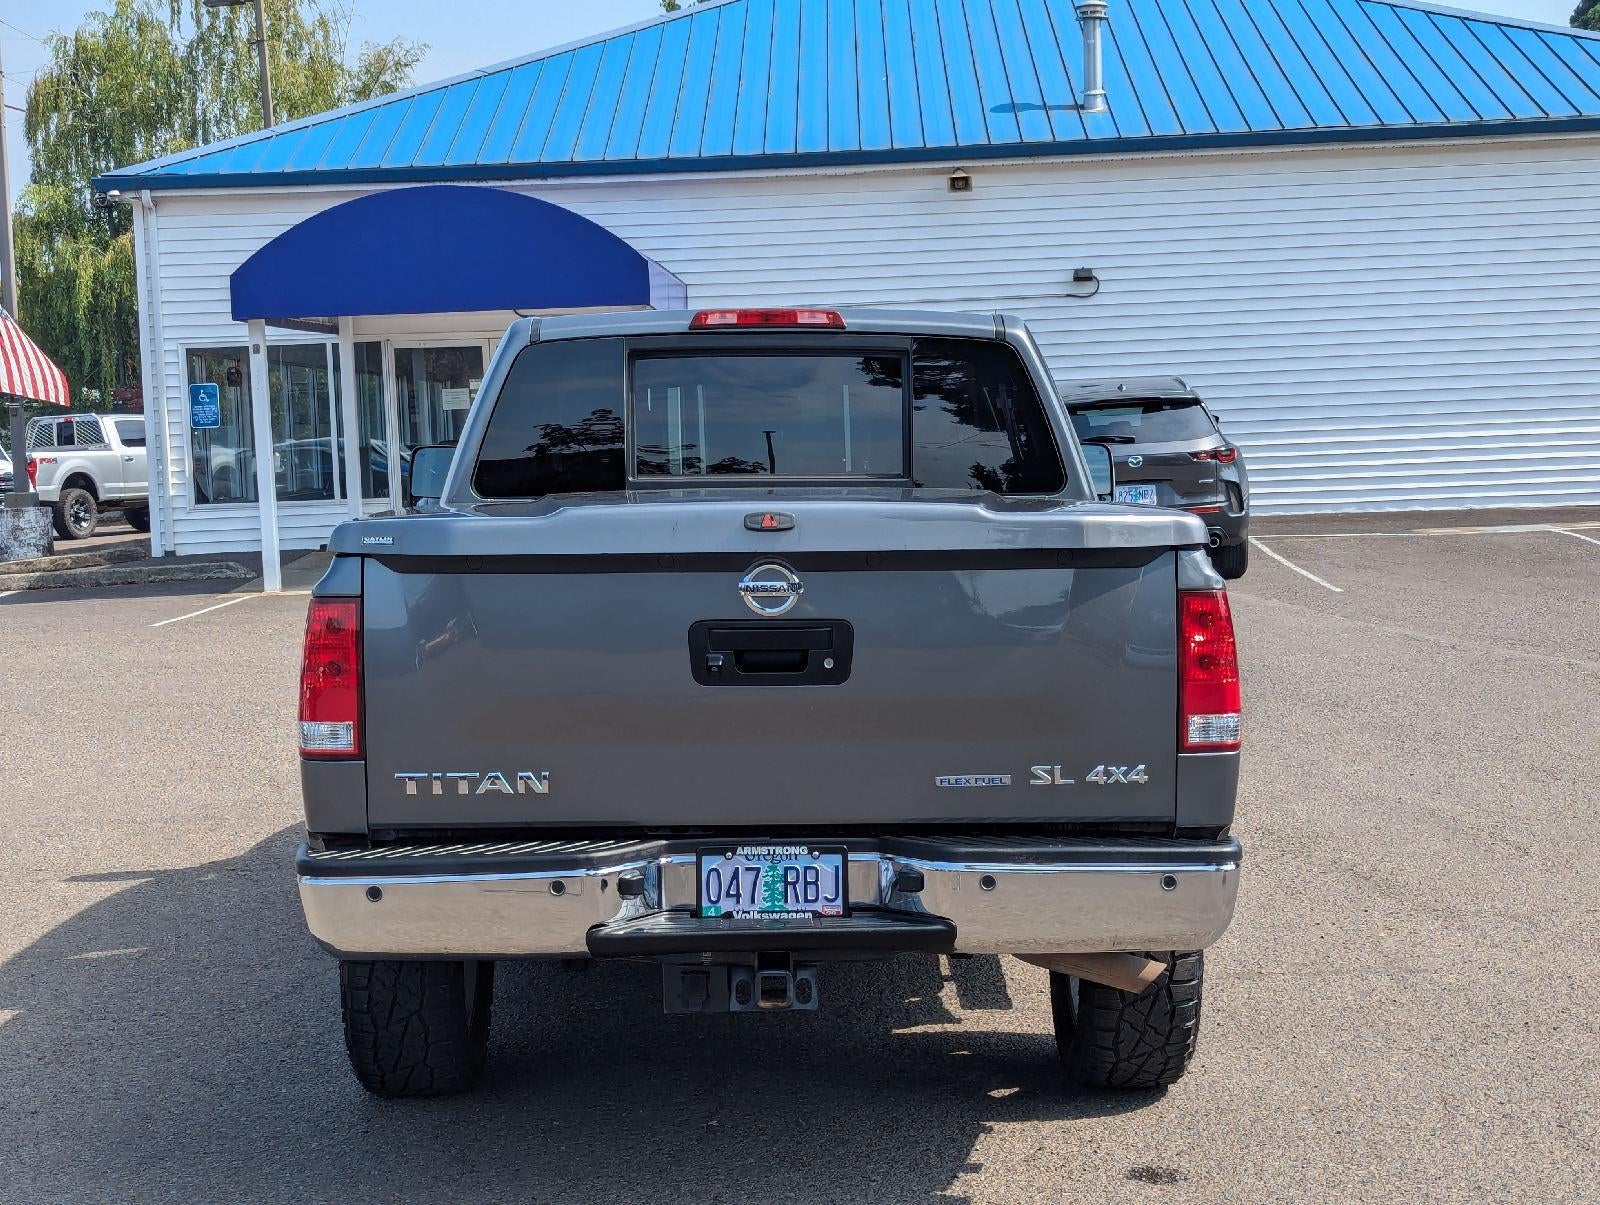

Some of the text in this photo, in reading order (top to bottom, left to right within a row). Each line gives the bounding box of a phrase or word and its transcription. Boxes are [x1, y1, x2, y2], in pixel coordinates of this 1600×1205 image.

[743, 584, 797, 593] NISSAN
[1029, 765, 1075, 785] SL
[394, 771, 549, 795] TITAN
[939, 777, 1006, 786] FLEX FUEL
[736, 846, 809, 855] ARMSTRONG
[705, 865, 840, 905] 047 RBJ
[732, 910, 814, 921] Volkswagen
